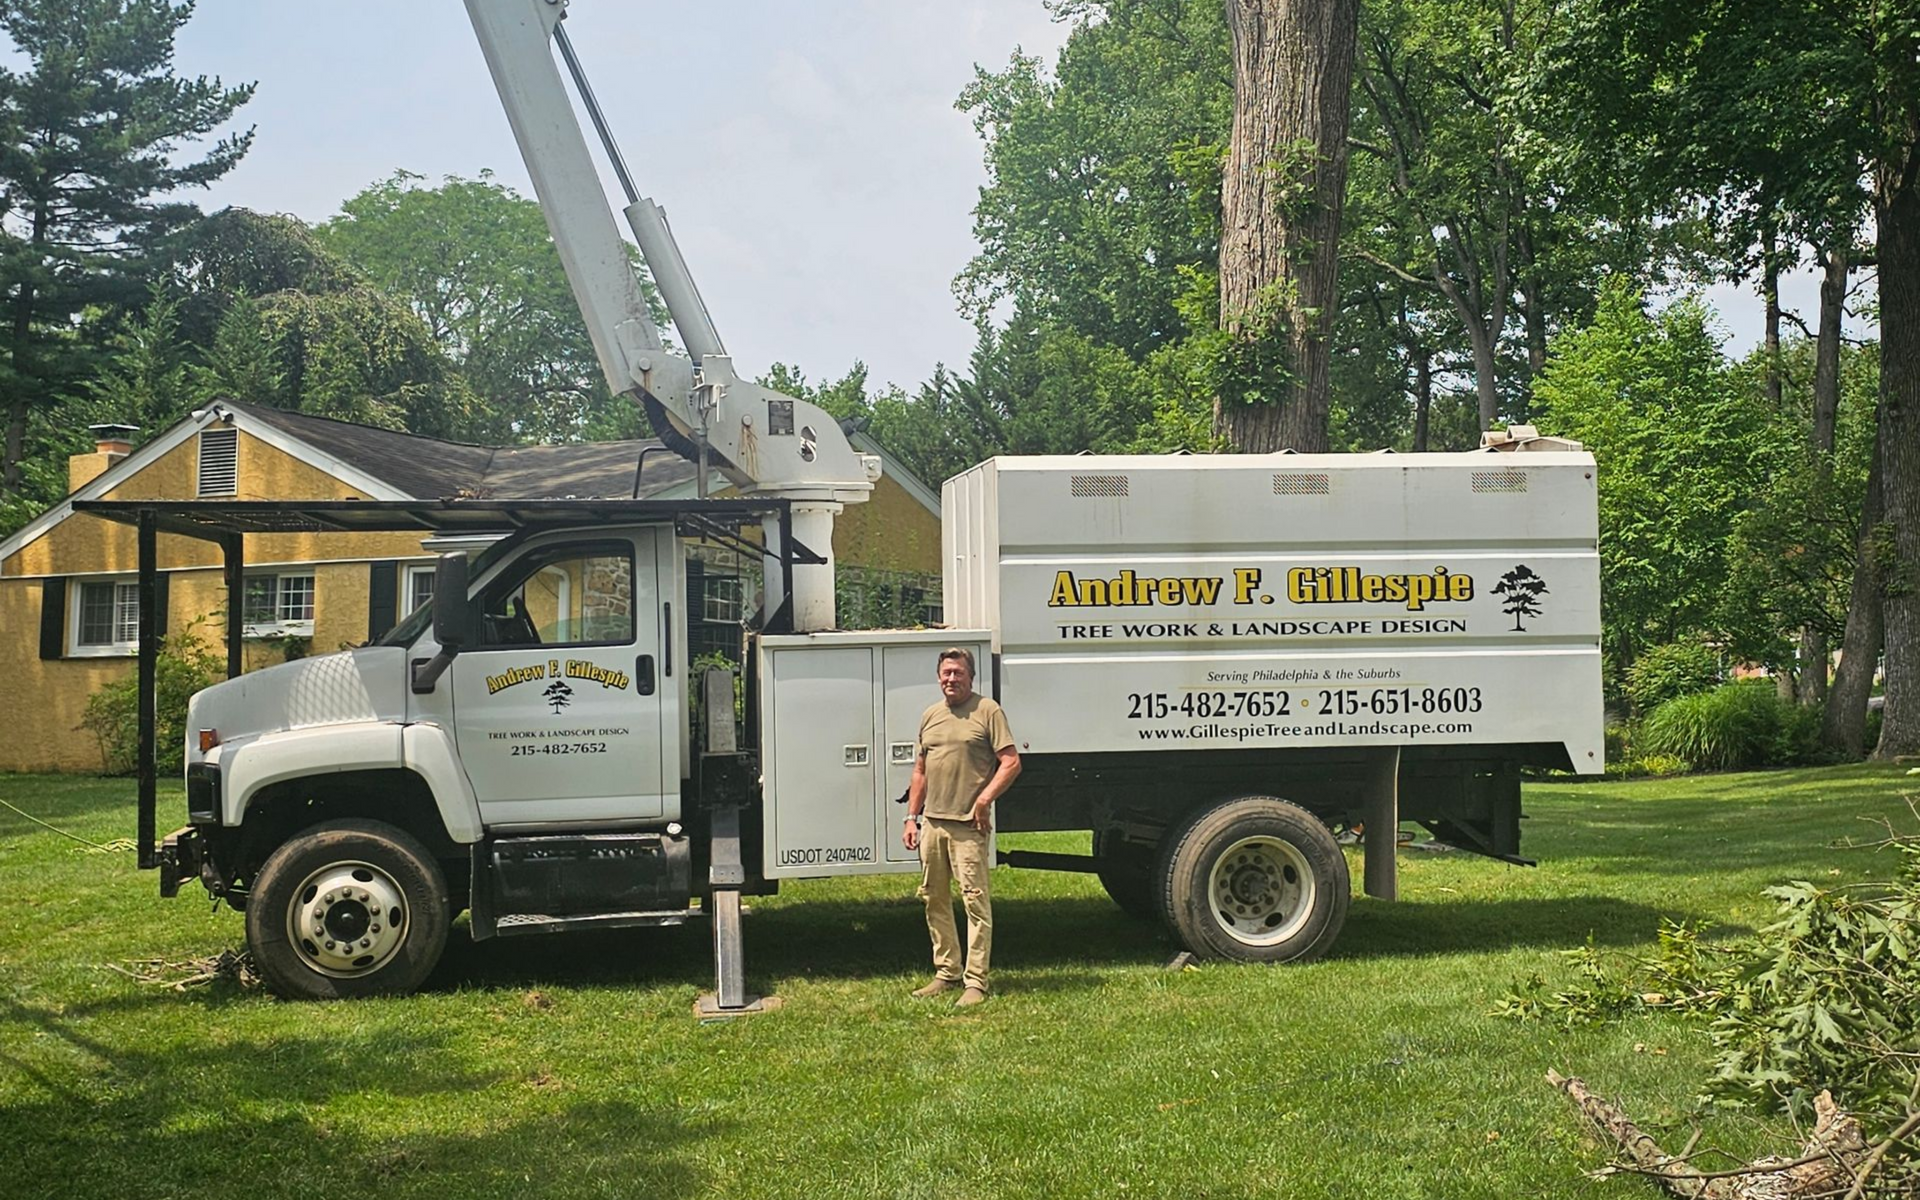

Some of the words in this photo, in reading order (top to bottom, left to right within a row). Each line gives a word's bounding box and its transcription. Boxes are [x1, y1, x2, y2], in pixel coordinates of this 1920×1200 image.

[1048, 570, 1223, 607] Andrew
[1233, 567, 1275, 605] F.
[1287, 566, 1474, 611] Gillespie
[1057, 625, 1113, 639] TREE
[1122, 623, 1199, 638] WORK
[1207, 623, 1224, 636] &
[1232, 621, 1372, 636] LANDSCAPE
[1382, 619, 1467, 634] DESIGN
[486, 664, 545, 695] Andrew
[549, 659, 561, 678] F.
[566, 660, 630, 690] Gillespie
[1207, 670, 1248, 684] Serving
[1252, 669, 1319, 683] Philadelphia
[1323, 669, 1331, 679] &
[1336, 669, 1353, 679] the
[1357, 668, 1401, 679] Suburbs
[1127, 690, 1290, 718] 215-482-7652
[1318, 687, 1482, 715] 215-651-8603
[488, 732, 507, 740] TREE
[510, 730, 537, 739] WORK
[548, 729, 596, 738] LANDSCAPE
[599, 728, 629, 736] DESIGN
[1138, 721, 1473, 742] www.GillespieTreeandLandscape.com
[511, 742, 607, 757] 215-482-7652
[781, 848, 823, 865] USDOT
[826, 846, 871, 862] 2407402
